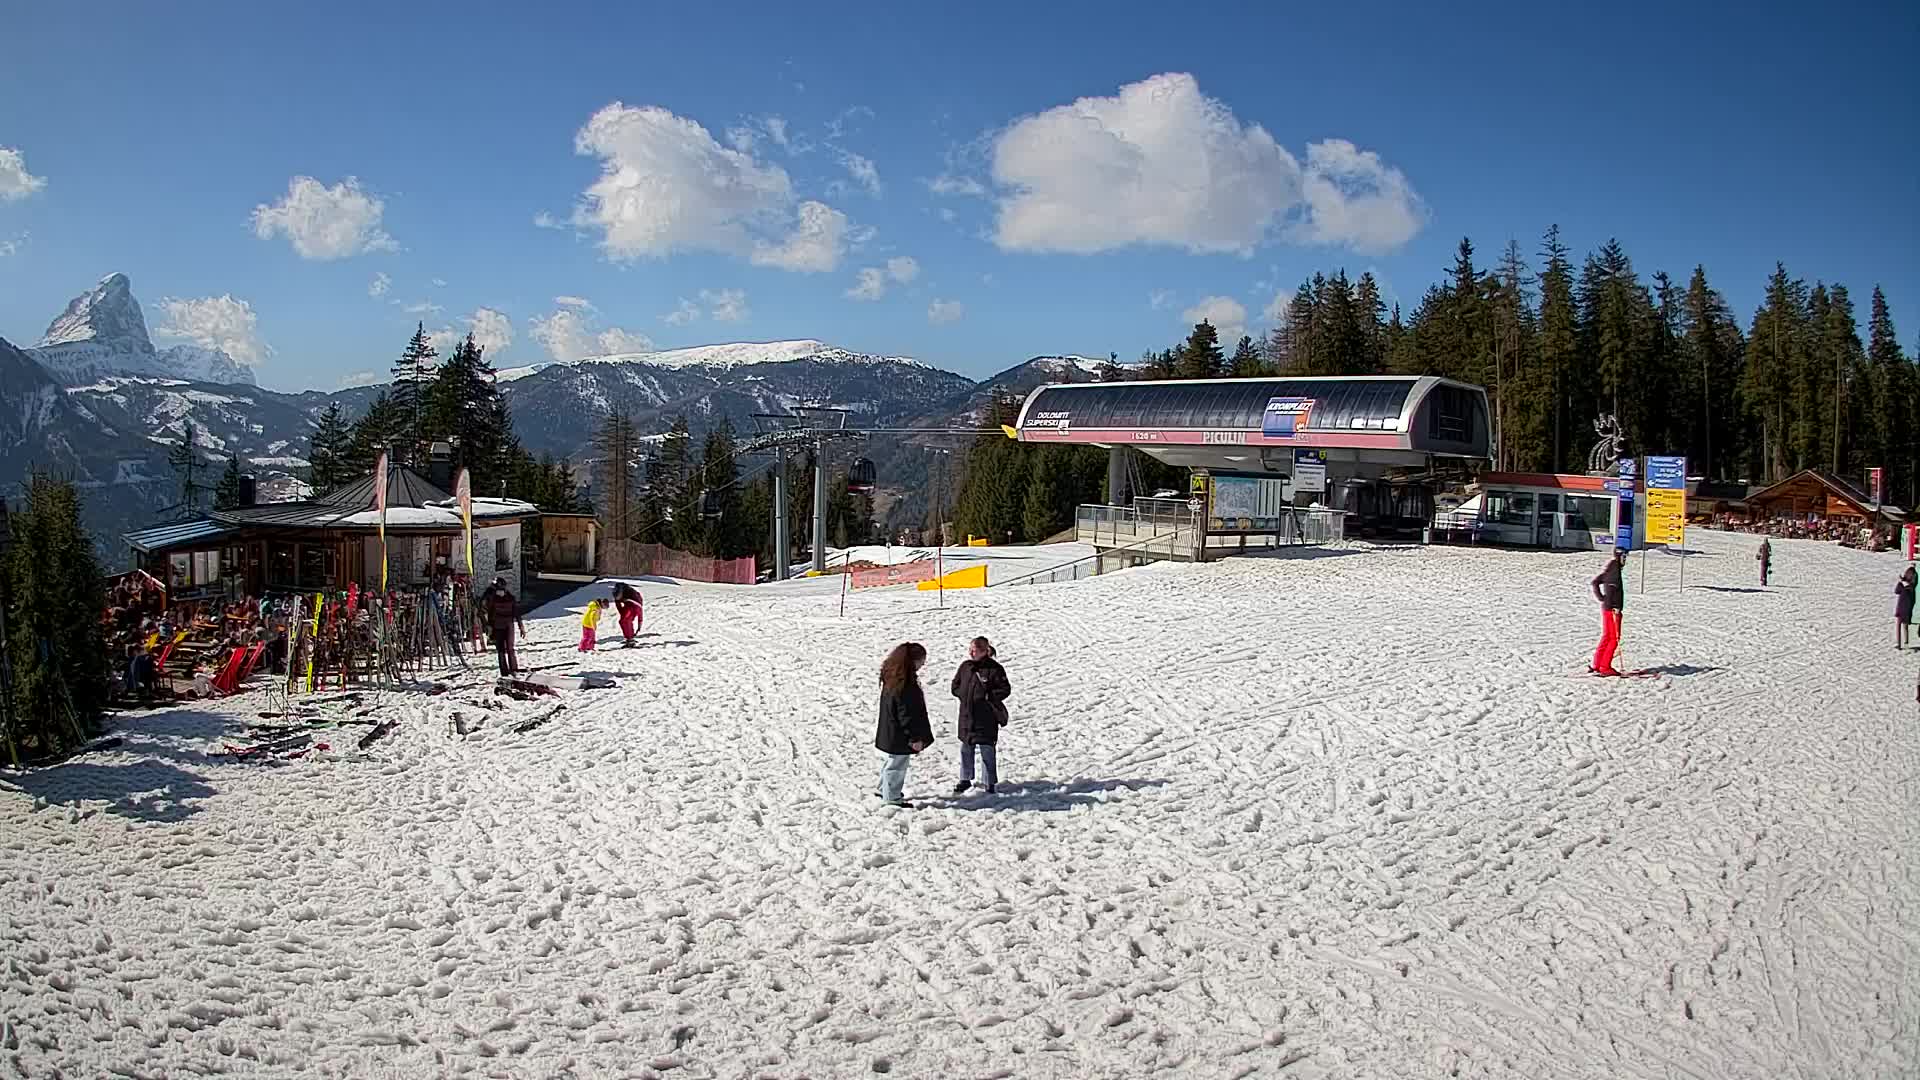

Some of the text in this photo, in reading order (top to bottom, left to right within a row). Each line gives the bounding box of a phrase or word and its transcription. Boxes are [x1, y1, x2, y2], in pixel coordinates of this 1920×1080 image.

[1037, 411, 1070, 419] DOLOMITI
[1025, 419, 1059, 427] SUPERSKI
[1201, 431, 1247, 445] PICULIN
